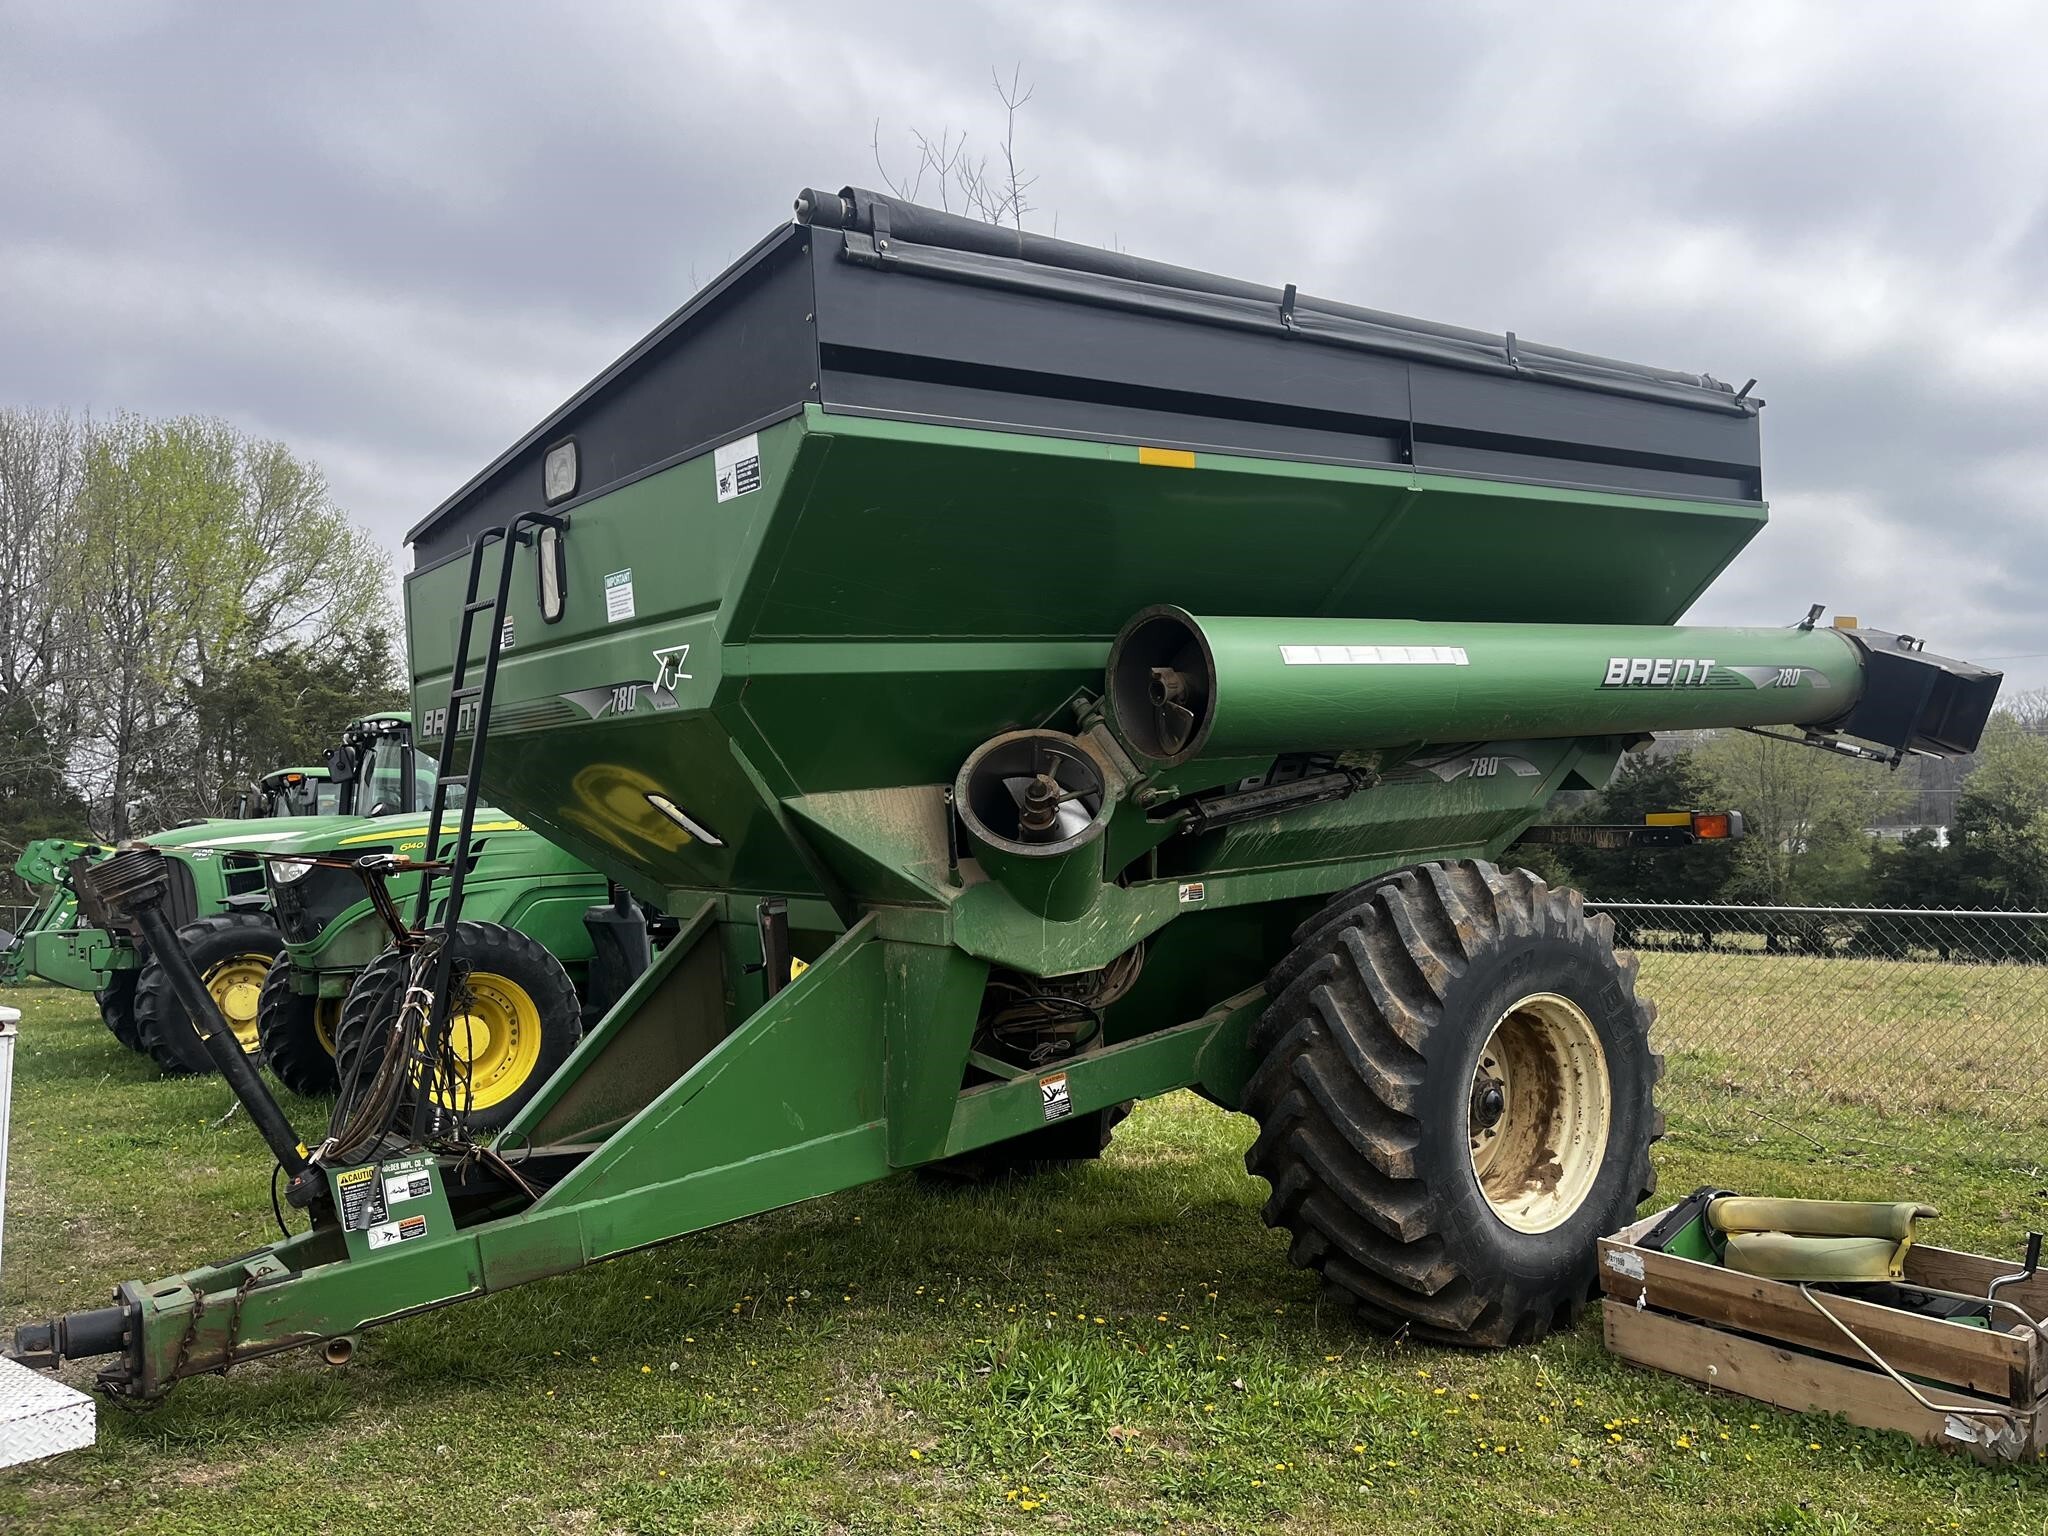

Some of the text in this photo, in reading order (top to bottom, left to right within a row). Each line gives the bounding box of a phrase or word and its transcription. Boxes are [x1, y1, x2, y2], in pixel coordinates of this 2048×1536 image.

[606, 571, 631, 588] IMPORTANT
[1603, 656, 1801, 688] BRENT 780
[422, 685, 637, 736] BRNT 780
[1467, 757, 1499, 778] 780
[400, 841, 427, 851] 6140
[348, 1168, 375, 1182] CAUTIO
